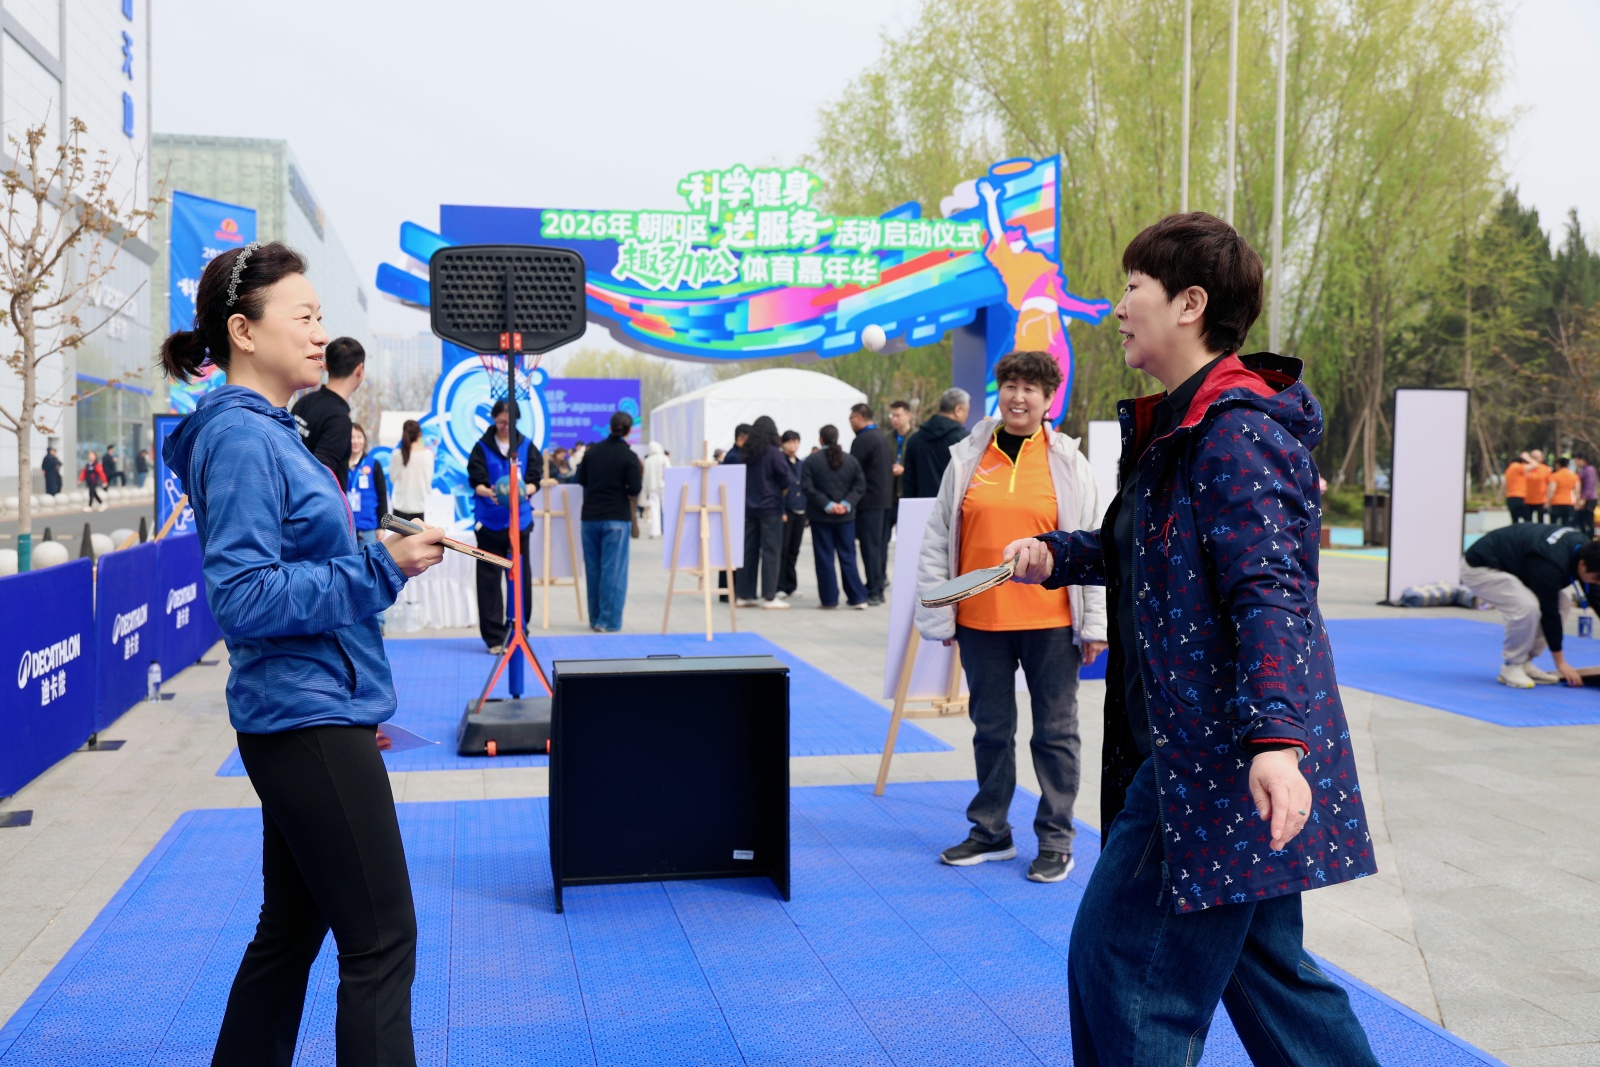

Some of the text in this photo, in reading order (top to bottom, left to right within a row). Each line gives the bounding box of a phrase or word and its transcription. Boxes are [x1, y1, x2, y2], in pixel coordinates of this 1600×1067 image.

[679, 165, 813, 223] 科学健身
[718, 208, 834, 248] 送服务
[611, 238, 879, 291] 趣劲松 体育嘉年华
[32, 632, 81, 679] DECATHLON
[41, 668, 66, 706] 迪卡侬
